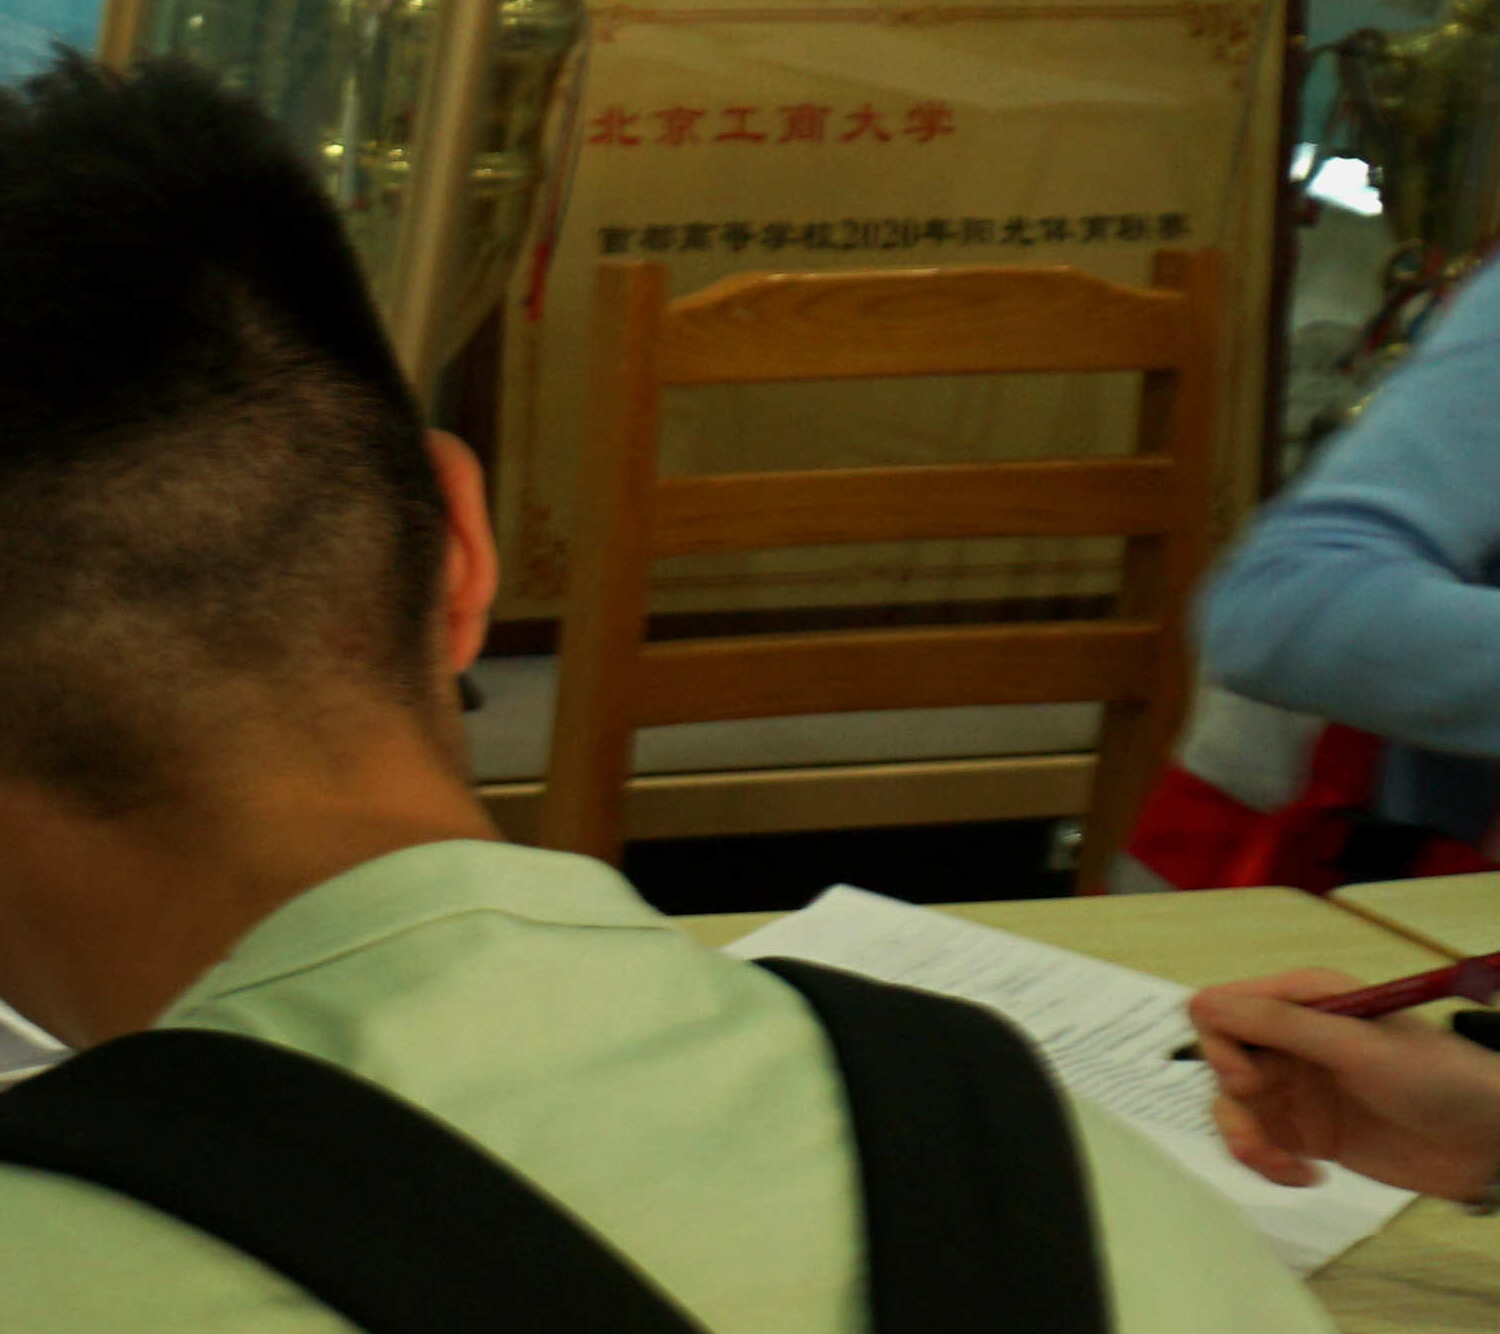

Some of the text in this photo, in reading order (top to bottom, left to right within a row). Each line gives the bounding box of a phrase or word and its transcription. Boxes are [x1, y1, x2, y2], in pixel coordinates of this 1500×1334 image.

[588, 100, 957, 147] 北京工商大学
